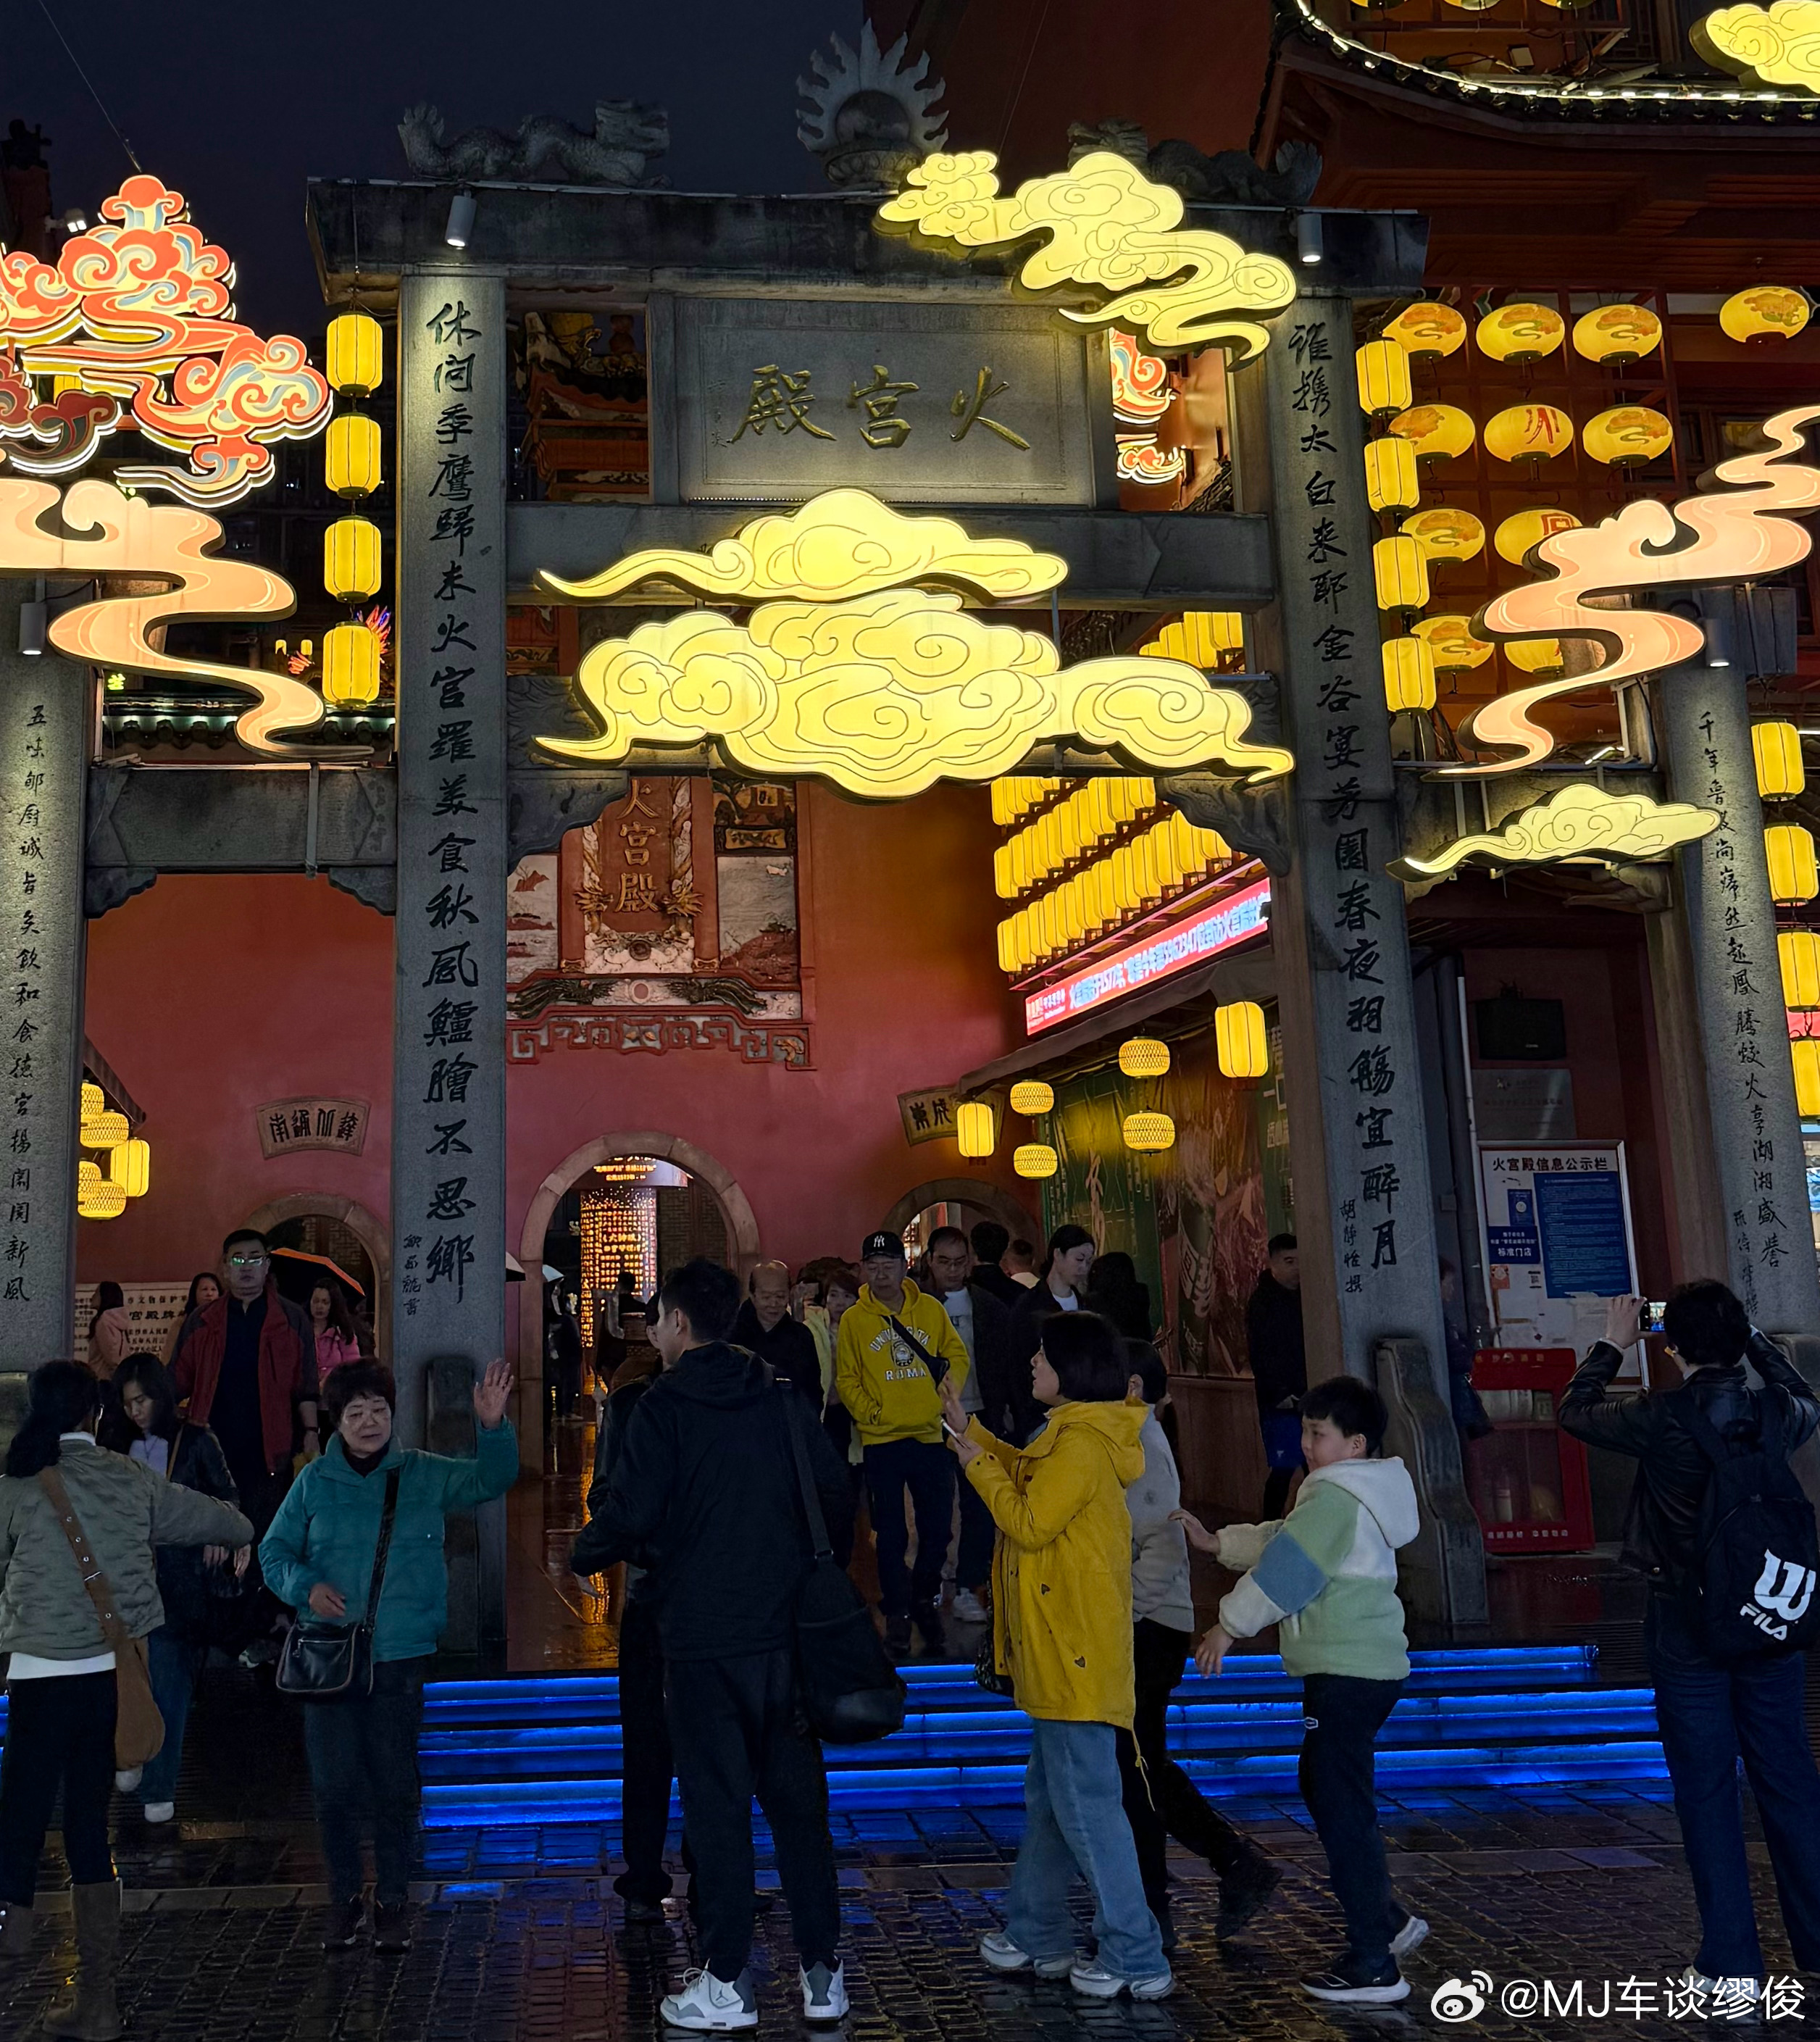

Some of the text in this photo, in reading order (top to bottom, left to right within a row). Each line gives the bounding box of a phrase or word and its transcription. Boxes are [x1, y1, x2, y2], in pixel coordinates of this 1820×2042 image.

[1493, 1157, 1608, 1172] 火宫殿信息公示栏
[1740, 1602, 1787, 1641] FILA
